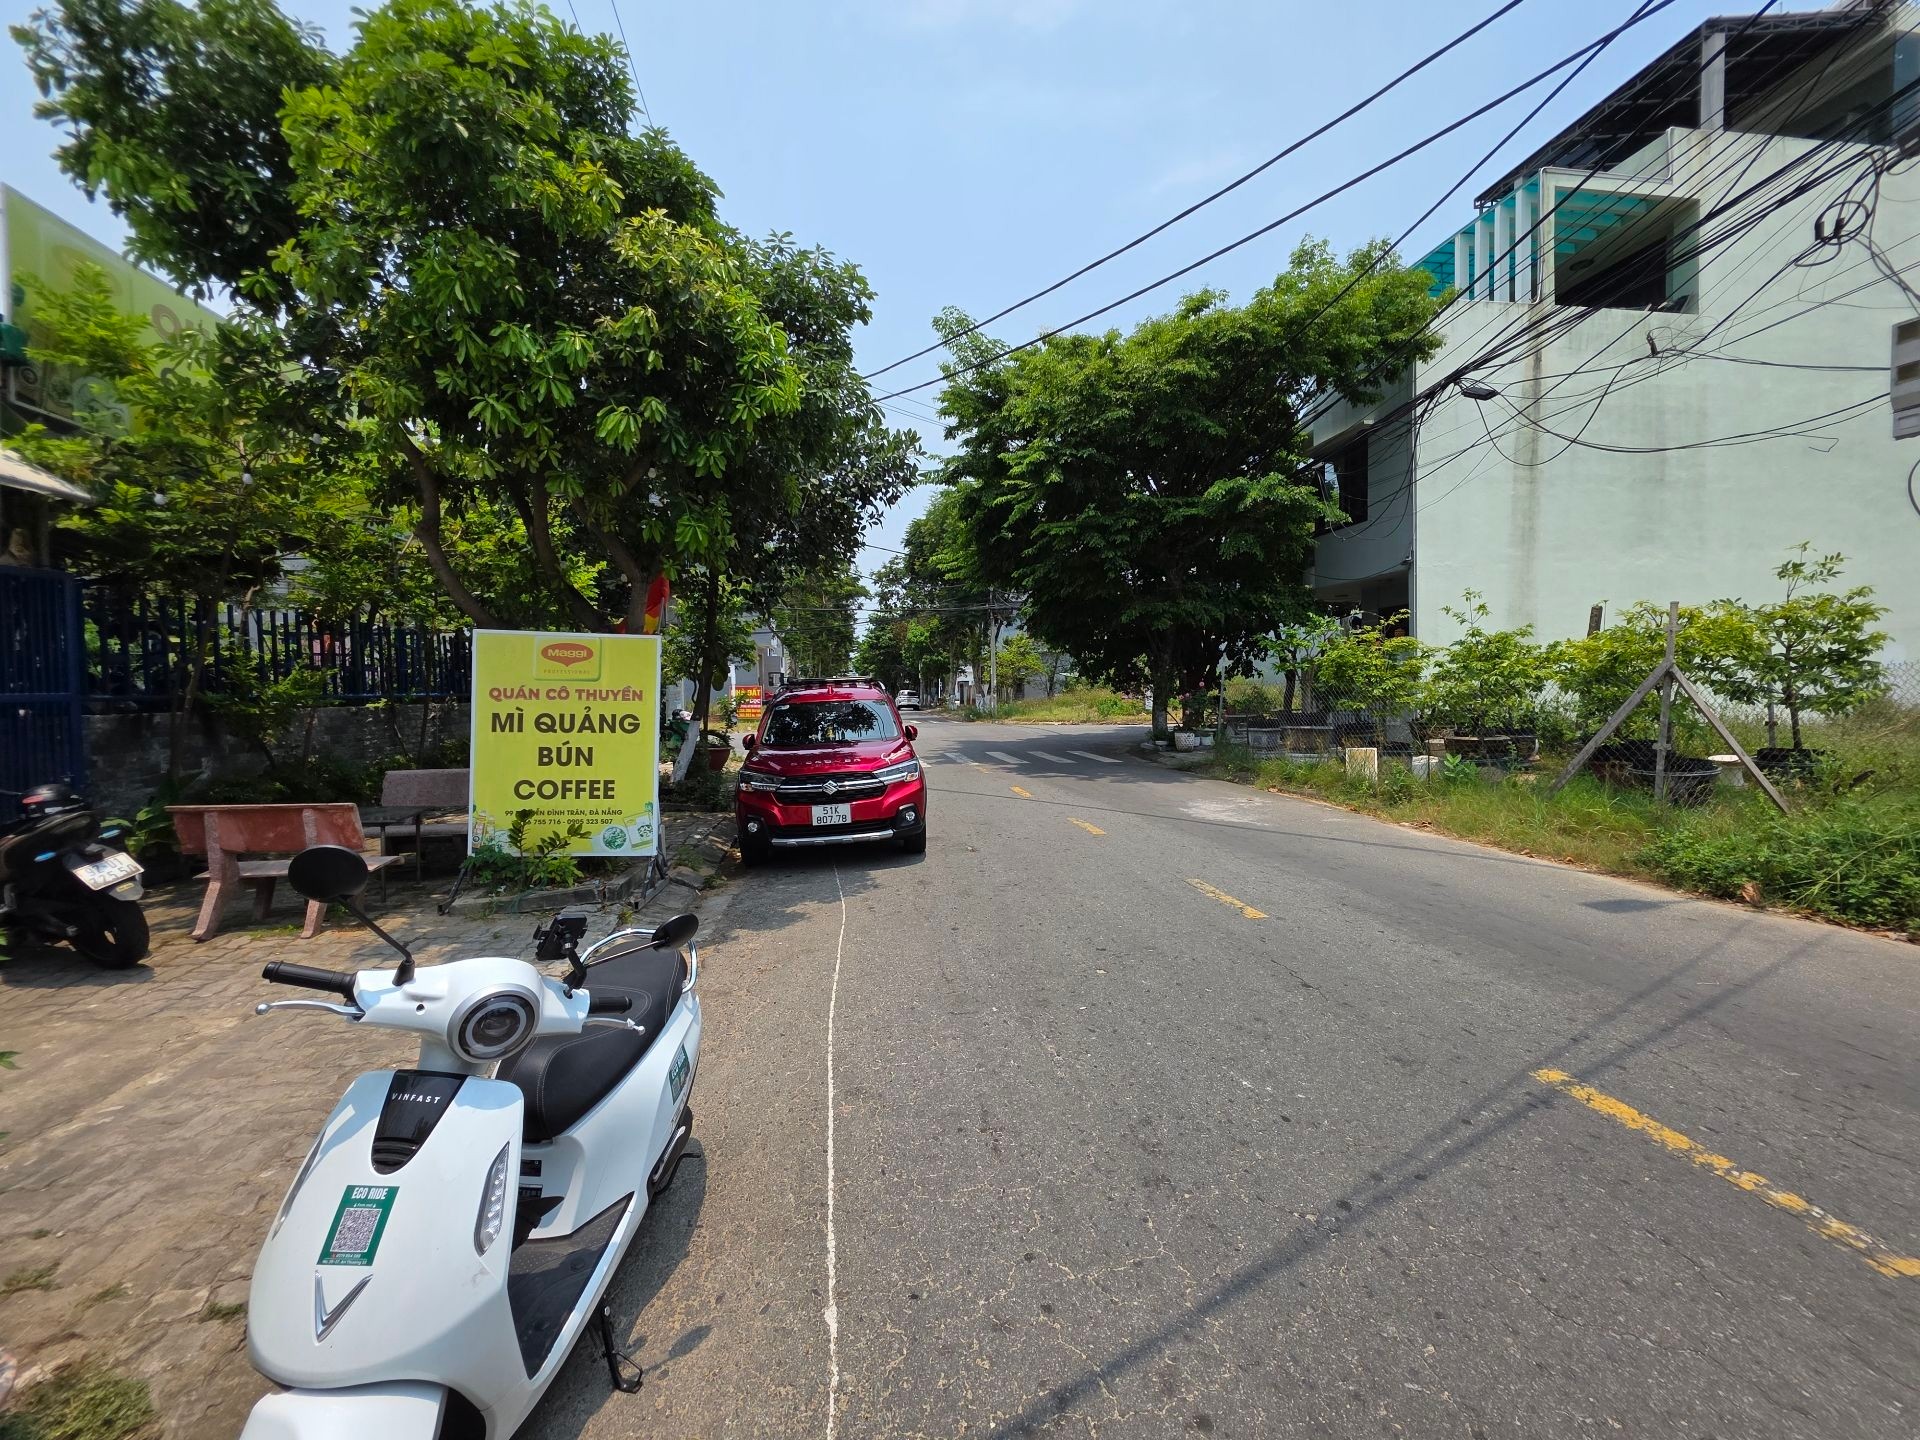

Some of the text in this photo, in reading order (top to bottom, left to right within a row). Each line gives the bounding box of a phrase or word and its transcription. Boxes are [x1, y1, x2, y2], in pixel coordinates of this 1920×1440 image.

[547, 648, 588, 658] Maggi
[489, 685, 540, 702] QUÁN
[545, 686, 570, 701] CÔ
[491, 706, 641, 734] MÌ QUẢNG
[538, 740, 593, 767] BÚN
[513, 779, 616, 801] COFFEE
[547, 808, 565, 816] ĐÌNH
[589, 808, 600, 816] ĐÀ
[823, 806, 839, 815] 51K
[816, 814, 848, 825] 807.78
[391, 1093, 442, 1104] VINFAST
[351, 1187, 389, 1200] ECO RIDE
